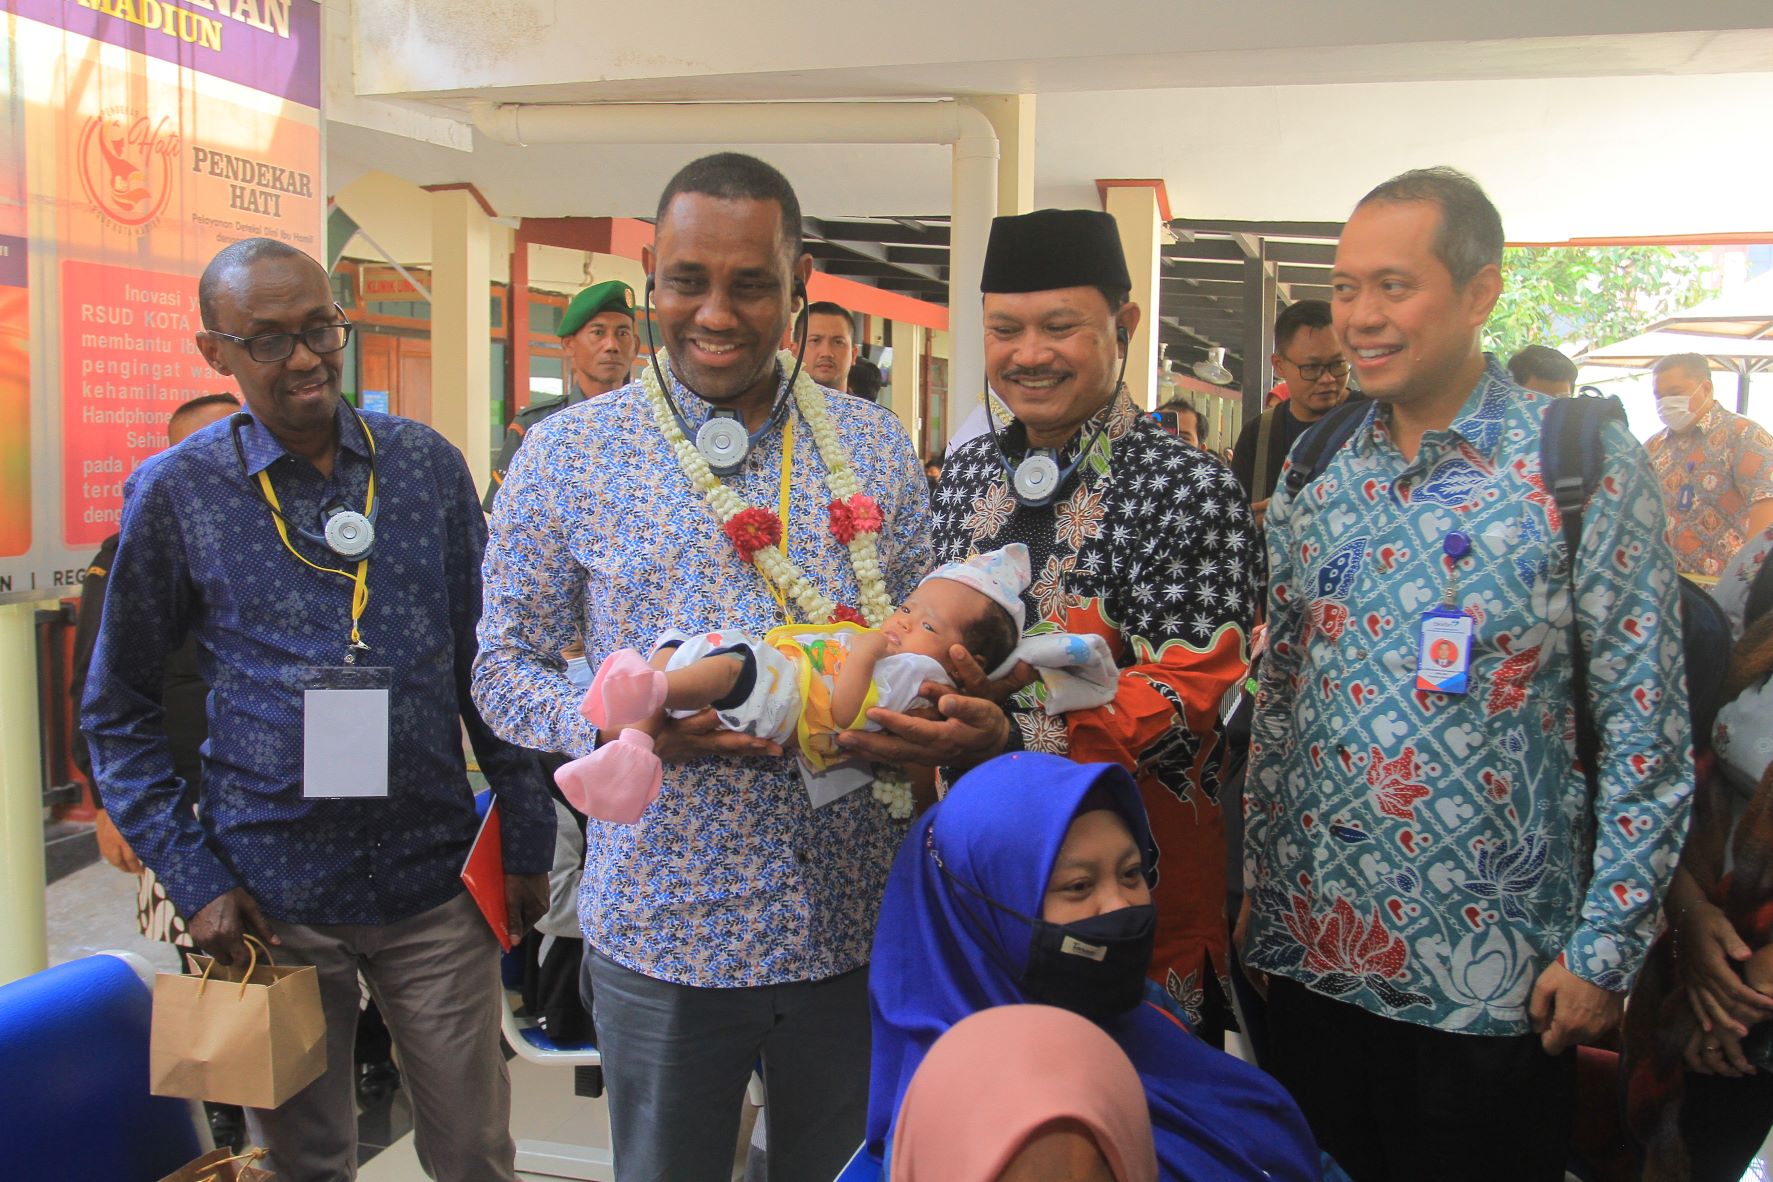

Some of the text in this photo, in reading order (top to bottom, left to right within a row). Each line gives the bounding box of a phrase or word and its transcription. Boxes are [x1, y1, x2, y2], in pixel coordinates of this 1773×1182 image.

[192, 146, 313, 198] PENDEKAR
[229, 184, 281, 217] HATI
[125, 284, 181, 306] Inovasi
[81, 304, 134, 325] RSUD
[144, 311, 191, 331] KOTA
[81, 333, 172, 353] membantu
[82, 359, 182, 379] pengingat
[82, 405, 172, 427] Handphone
[83, 457, 123, 478] pada
